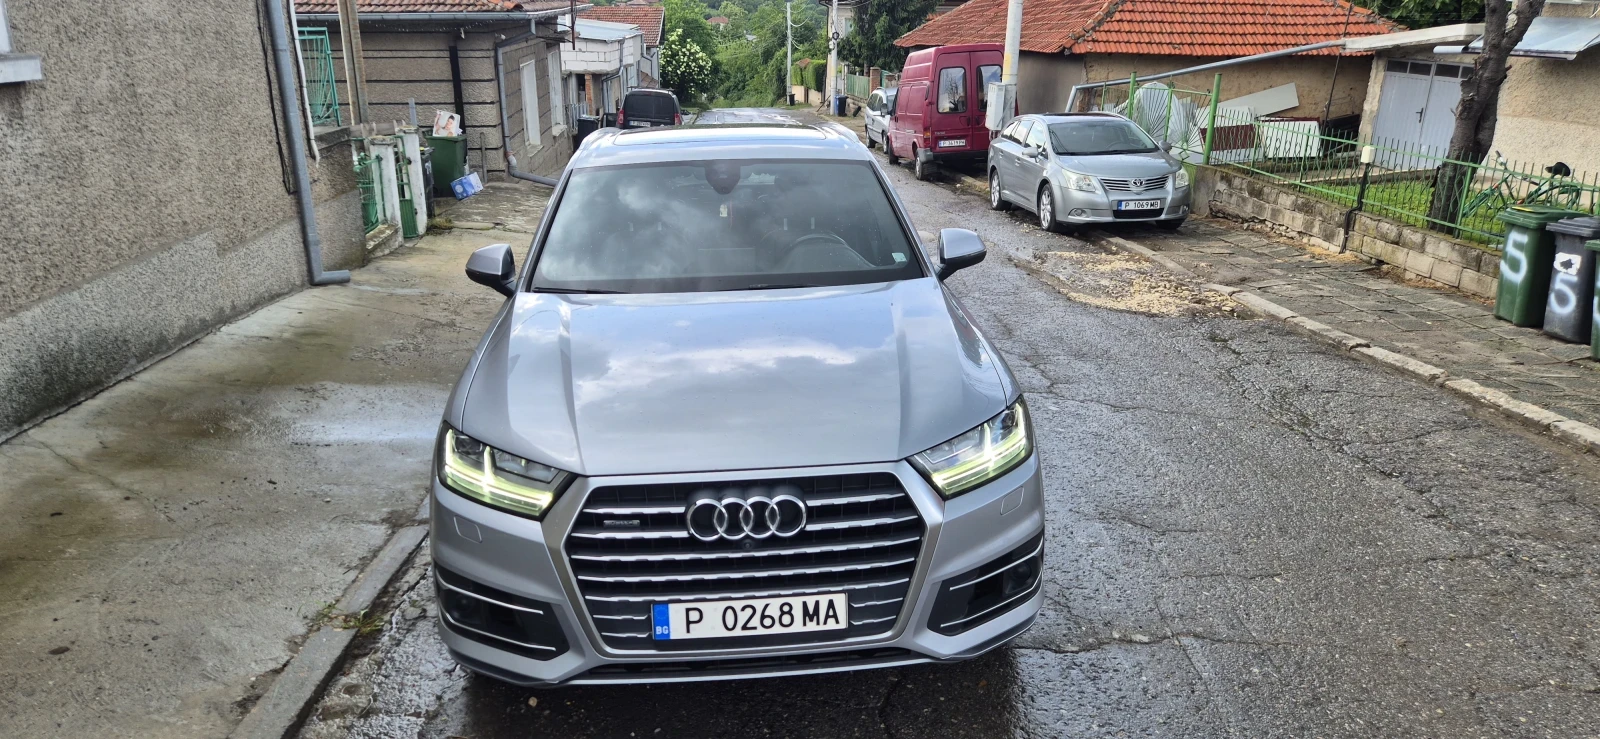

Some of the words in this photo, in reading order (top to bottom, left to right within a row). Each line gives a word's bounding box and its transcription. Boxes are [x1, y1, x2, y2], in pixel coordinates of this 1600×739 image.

[1500, 230, 1529, 284] 5
[1550, 272, 1579, 315] 5
[655, 625, 669, 635] BG
[685, 607, 704, 634] P
